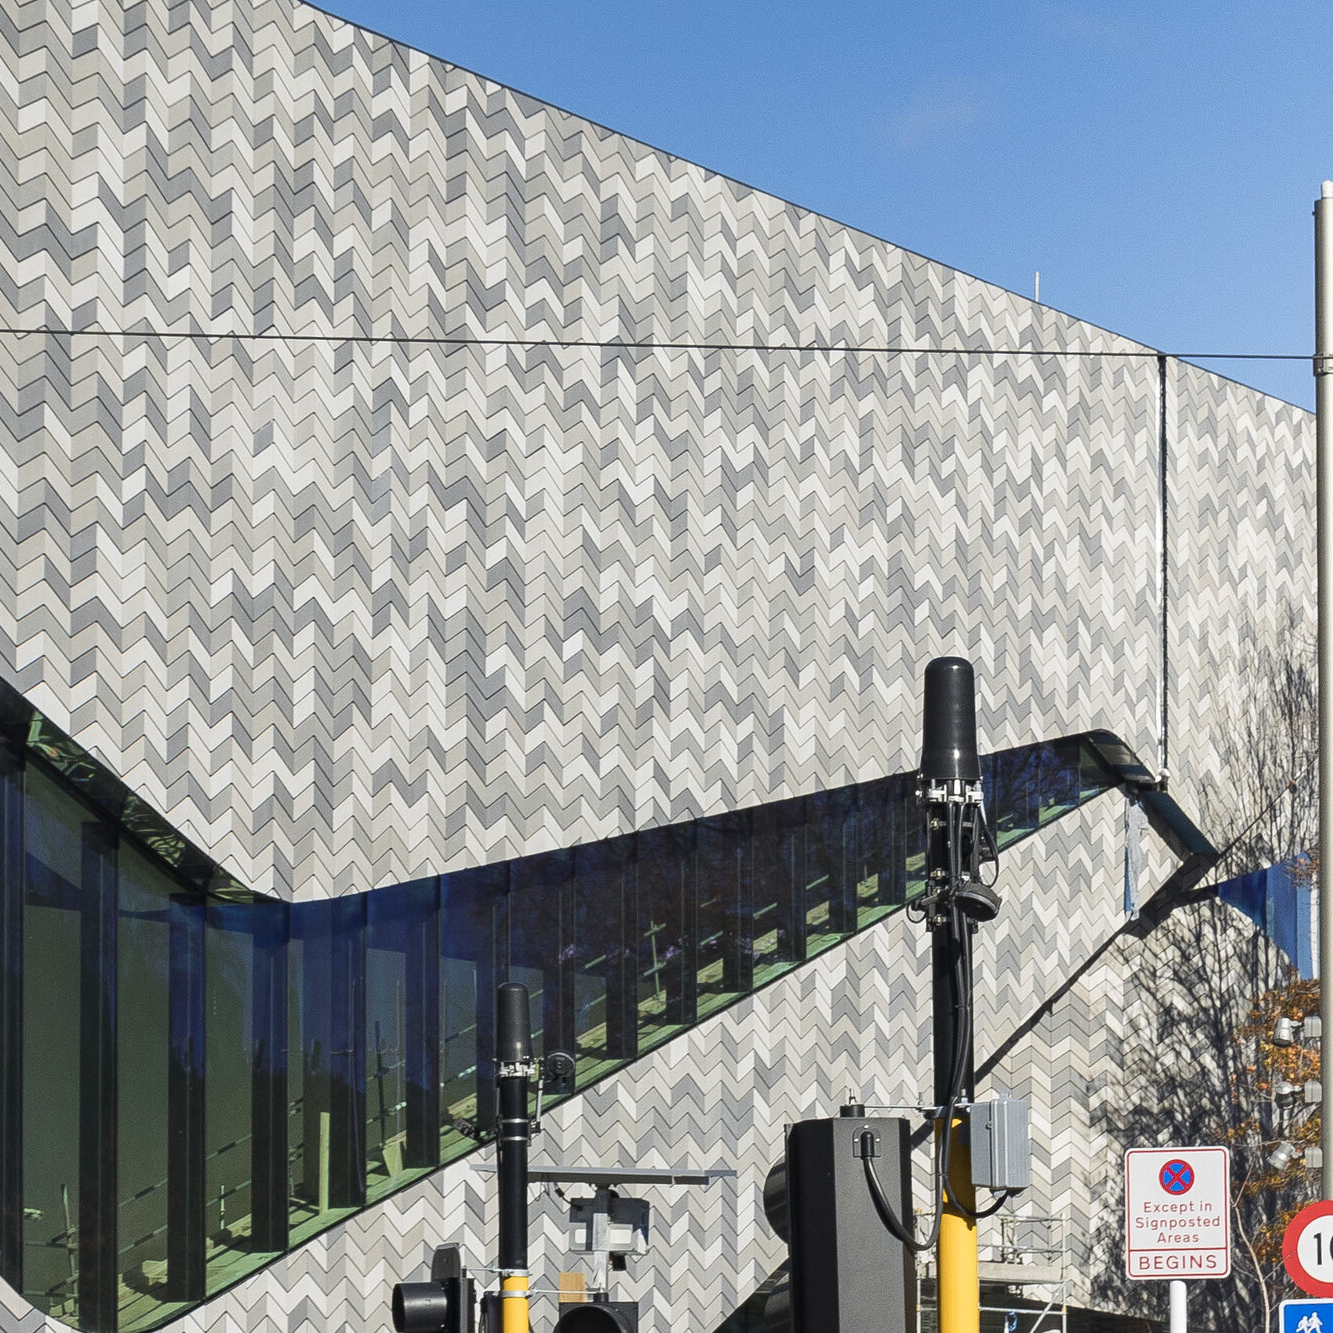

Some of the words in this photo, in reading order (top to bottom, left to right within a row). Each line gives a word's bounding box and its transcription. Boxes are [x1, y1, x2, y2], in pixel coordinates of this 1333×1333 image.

[1143, 1201, 1195, 1215] Except
[1199, 1200, 1213, 1212] in
[1135, 1215, 1221, 1230] Signposted
[1157, 1232, 1200, 1243] Areas
[1138, 1254, 1217, 1270] BEGINS
